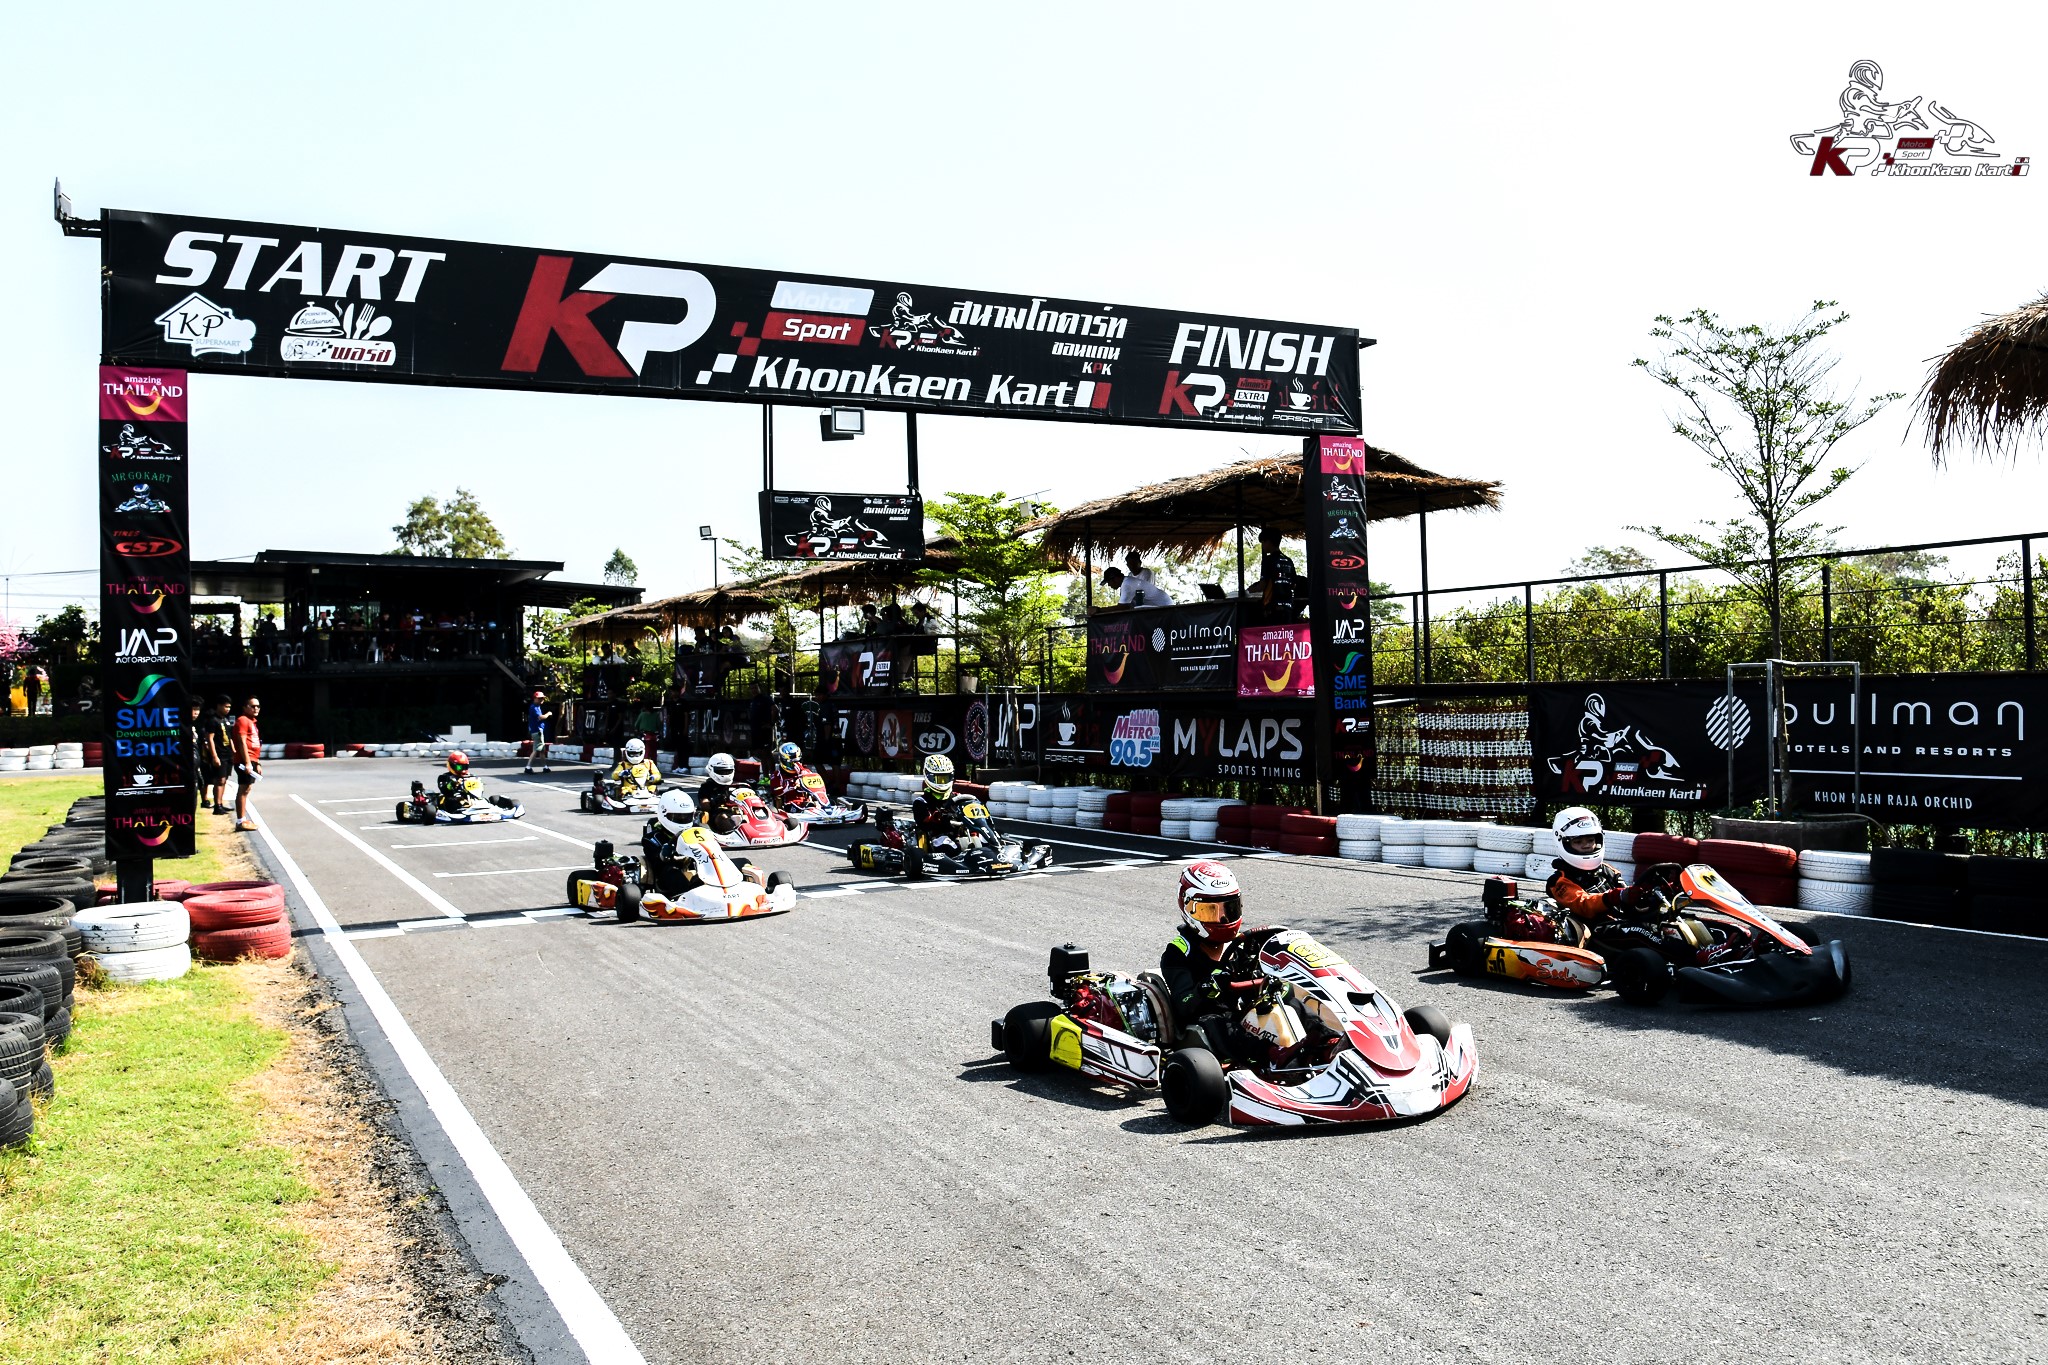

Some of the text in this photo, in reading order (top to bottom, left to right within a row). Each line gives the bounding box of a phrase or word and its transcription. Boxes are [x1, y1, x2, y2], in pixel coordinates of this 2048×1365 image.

[155, 231, 447, 303] START
[780, 289, 856, 311] Motor
[500, 255, 717, 378] KP
[178, 312, 223, 338] KP
[782, 318, 852, 342] Sport
[1168, 322, 1335, 376] FINISH
[124, 376, 162, 385] amazing
[748, 355, 1076, 409] KhonKaen Kart
[103, 383, 183, 397] THAILAND
[1158, 370, 1226, 415] KP
[1237, 391, 1265, 401] EXTRA
[1272, 414, 1323, 423] PORSCHE
[1322, 448, 1363, 458] THAILAND
[116, 541, 165, 553] CST
[1331, 559, 1355, 567] CST
[106, 583, 185, 595] THAILAND
[1170, 624, 1232, 645] pullman
[1262, 628, 1294, 641] amazing
[1090, 634, 1146, 655] THAILAND
[1245, 641, 1313, 662] THAILAND
[1334, 675, 1367, 690] SME
[1334, 696, 1367, 710] Bank
[116, 707, 180, 729] SME
[914, 711, 932, 722] TIRES
[1773, 693, 2024, 741] pullman
[116, 729, 180, 738] Development
[1112, 717, 1153, 739] METRO
[116, 738, 180, 757] Bank
[918, 732, 946, 749] CST
[1044, 754, 1085, 763] PORSCHE
[1110, 739, 1152, 767] 90.5
[1863, 745, 1901, 755] AND
[1915, 747, 2013, 757] RESORTS
[1218, 764, 1301, 779] SPORTS TIMING
[1616, 773, 1634, 781] Sport
[1610, 784, 1696, 800] KhonKaen Kart
[1814, 791, 1846, 803] KHON
[1887, 795, 1918, 807] RAJA
[1924, 796, 1972, 810] ORCHID
[113, 813, 192, 829] THAILAND
[1242, 1018, 1279, 1043] birelART
